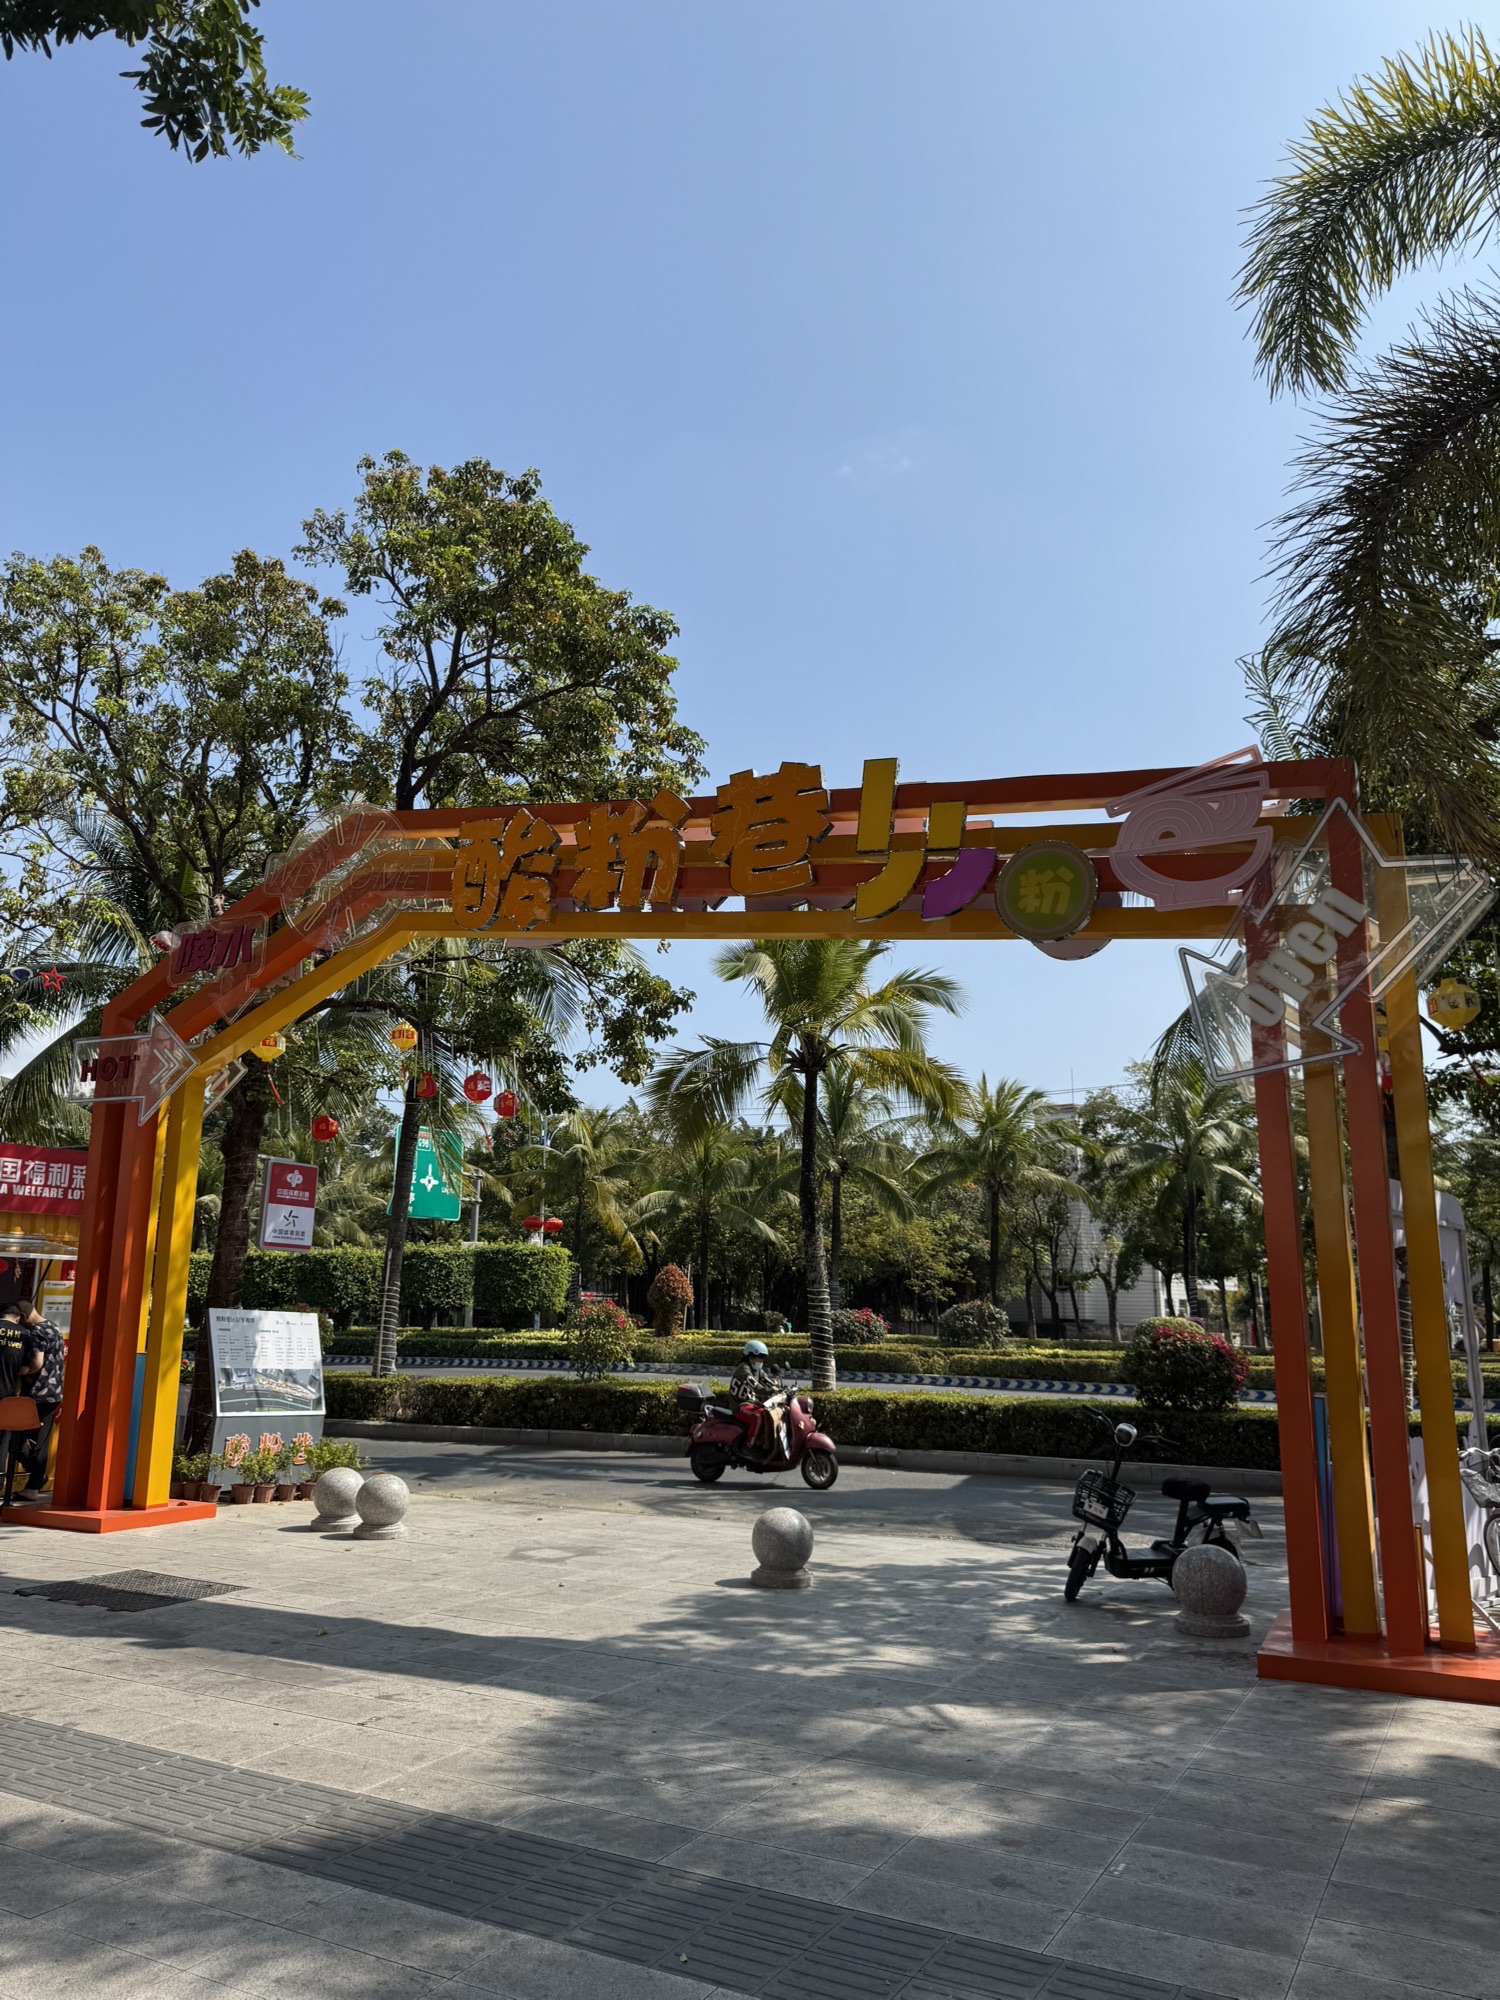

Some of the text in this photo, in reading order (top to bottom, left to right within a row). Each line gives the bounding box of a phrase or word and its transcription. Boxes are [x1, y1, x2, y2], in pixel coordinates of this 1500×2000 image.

[451, 762, 834, 932] 酸粉巷
[1017, 866, 1074, 915] 粉
[175, 924, 256, 975] 陵水
[80, 1055, 133, 1083] HOT
[12, 1184, 64, 1198] WELFARE
